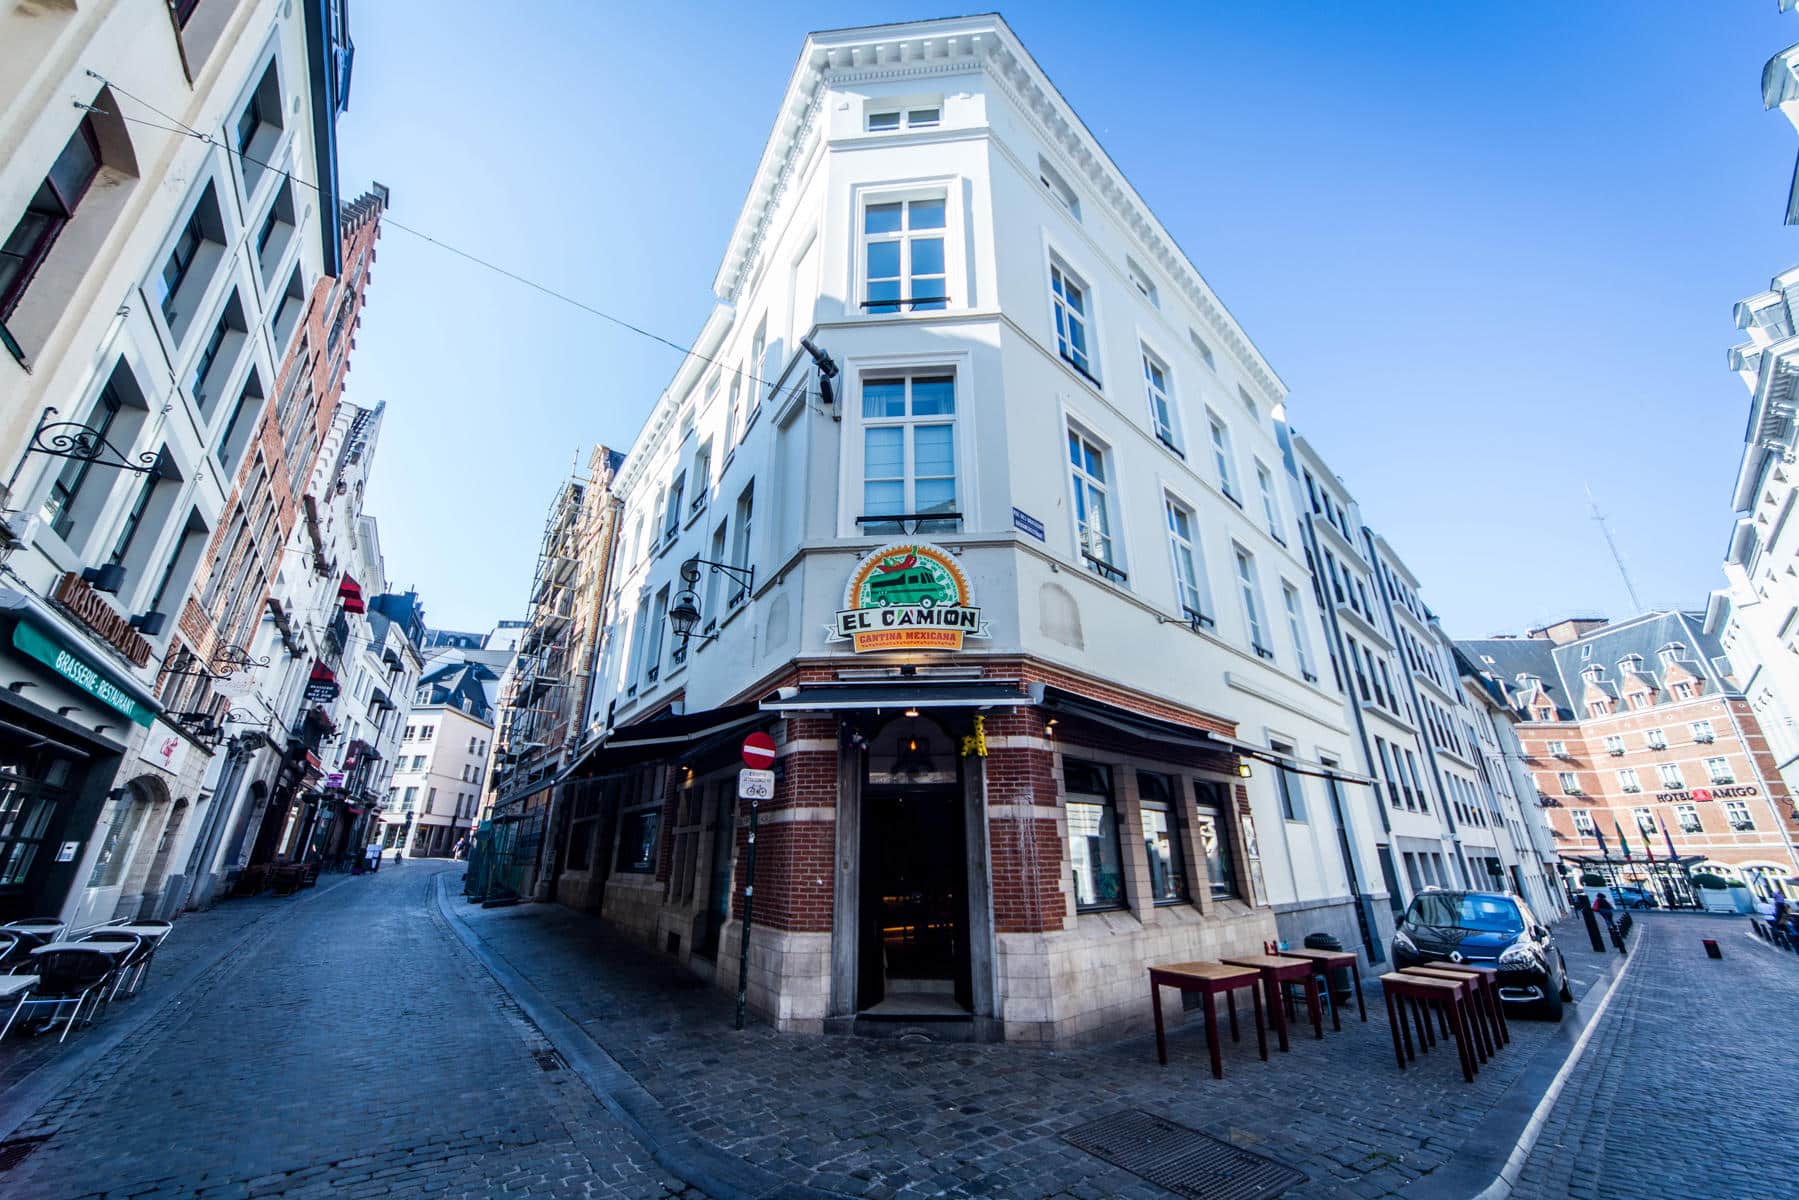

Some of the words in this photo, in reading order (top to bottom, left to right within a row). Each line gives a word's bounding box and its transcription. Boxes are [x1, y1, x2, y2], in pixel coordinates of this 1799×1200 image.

[63, 574, 114, 638] BRASSERIE
[843, 613, 871, 631] EL
[860, 632, 902, 644] CANTINA
[906, 631, 957, 642] MEXICANA
[56, 650, 98, 690] BRASSERIE
[97, 680, 136, 715] RESTAURANT
[1656, 791, 1693, 803] HOTEL
[1712, 786, 1757, 799] AMIGO
